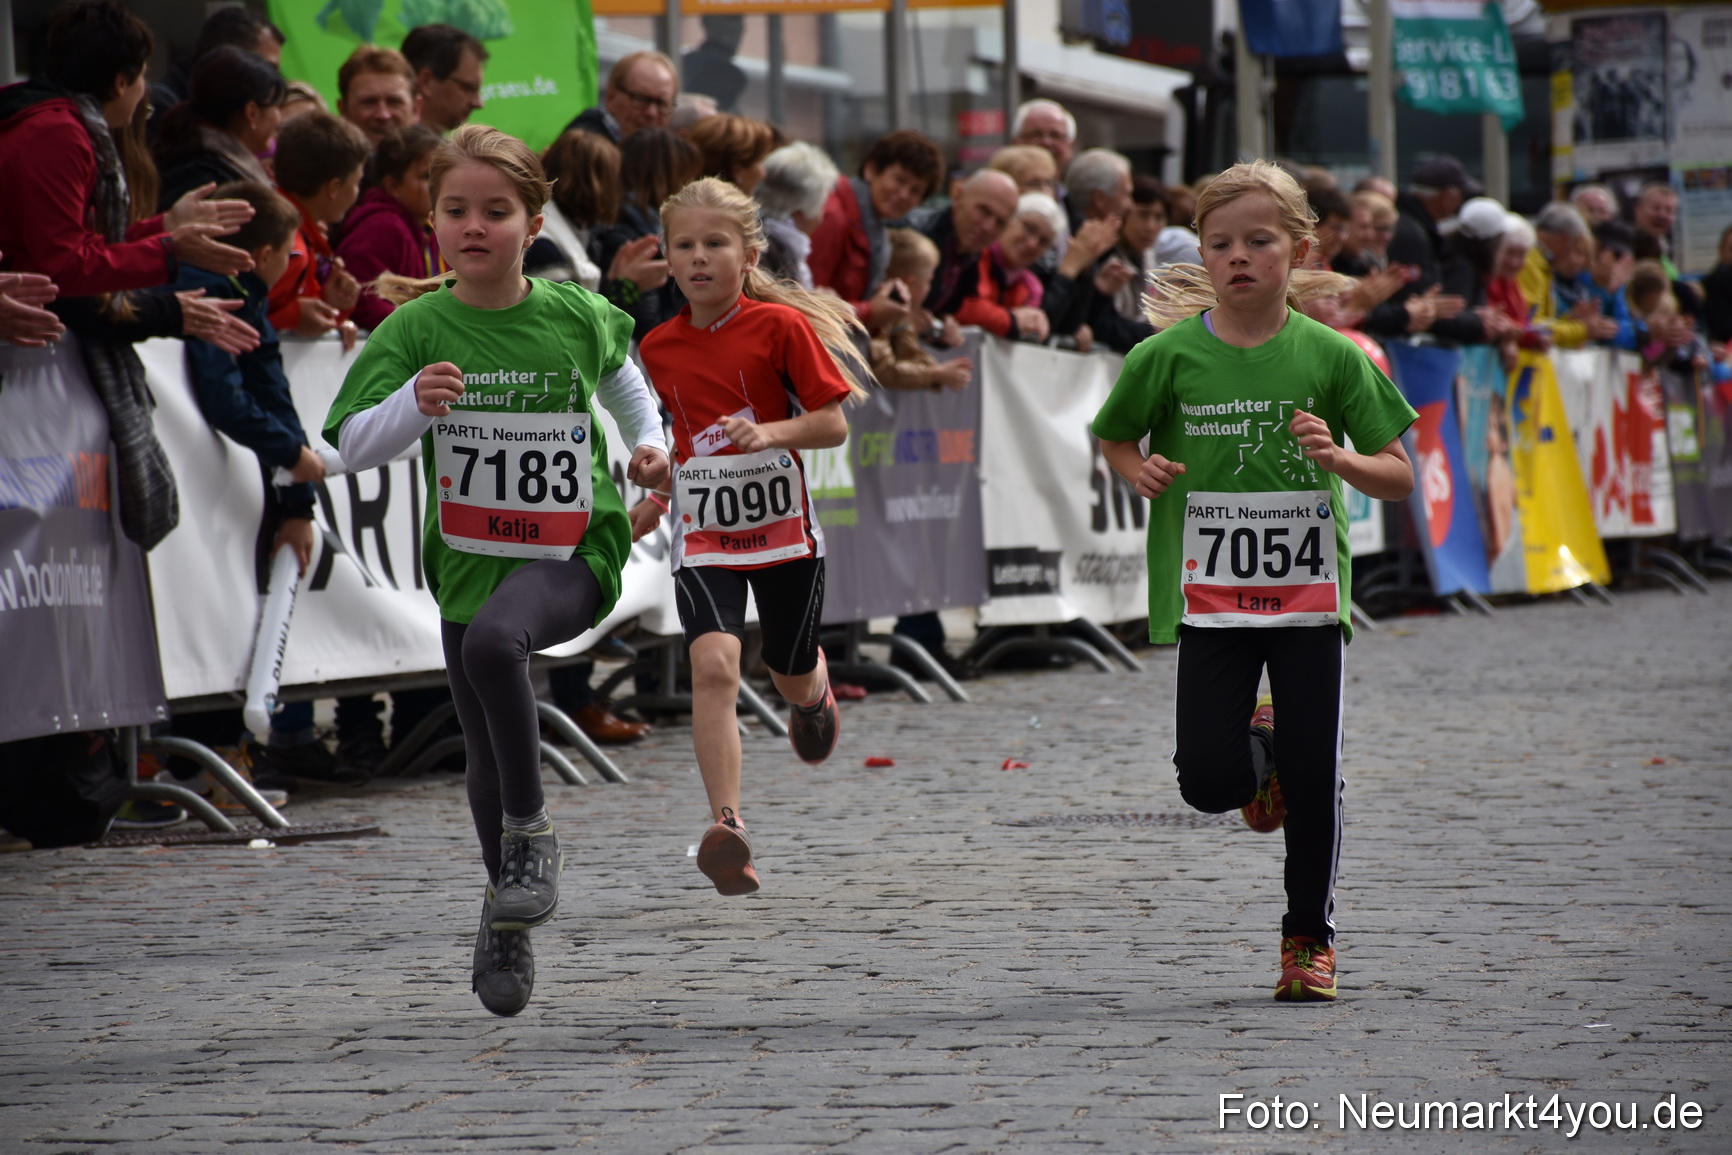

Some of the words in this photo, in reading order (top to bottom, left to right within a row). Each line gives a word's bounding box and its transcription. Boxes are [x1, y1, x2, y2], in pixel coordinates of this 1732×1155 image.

[462, 369, 537, 385] markter
[1181, 399, 1272, 416] Neumarkter
[438, 424, 489, 440] PARTL
[493, 428, 566, 442] Neumarkt
[1184, 419, 1251, 437] Stadtlauf
[452, 445, 579, 504] 7183
[679, 468, 716, 481] PARTL
[719, 462, 778, 480] Neumarkt
[688, 475, 792, 530] 7090
[1188, 506, 1234, 519] PARTL
[1238, 506, 1311, 520] Neumarkt
[488, 516, 540, 542] Katja
[720, 533, 768, 550] Paula
[1198, 526, 1324, 579] 7054
[1237, 593, 1282, 612] Lara
